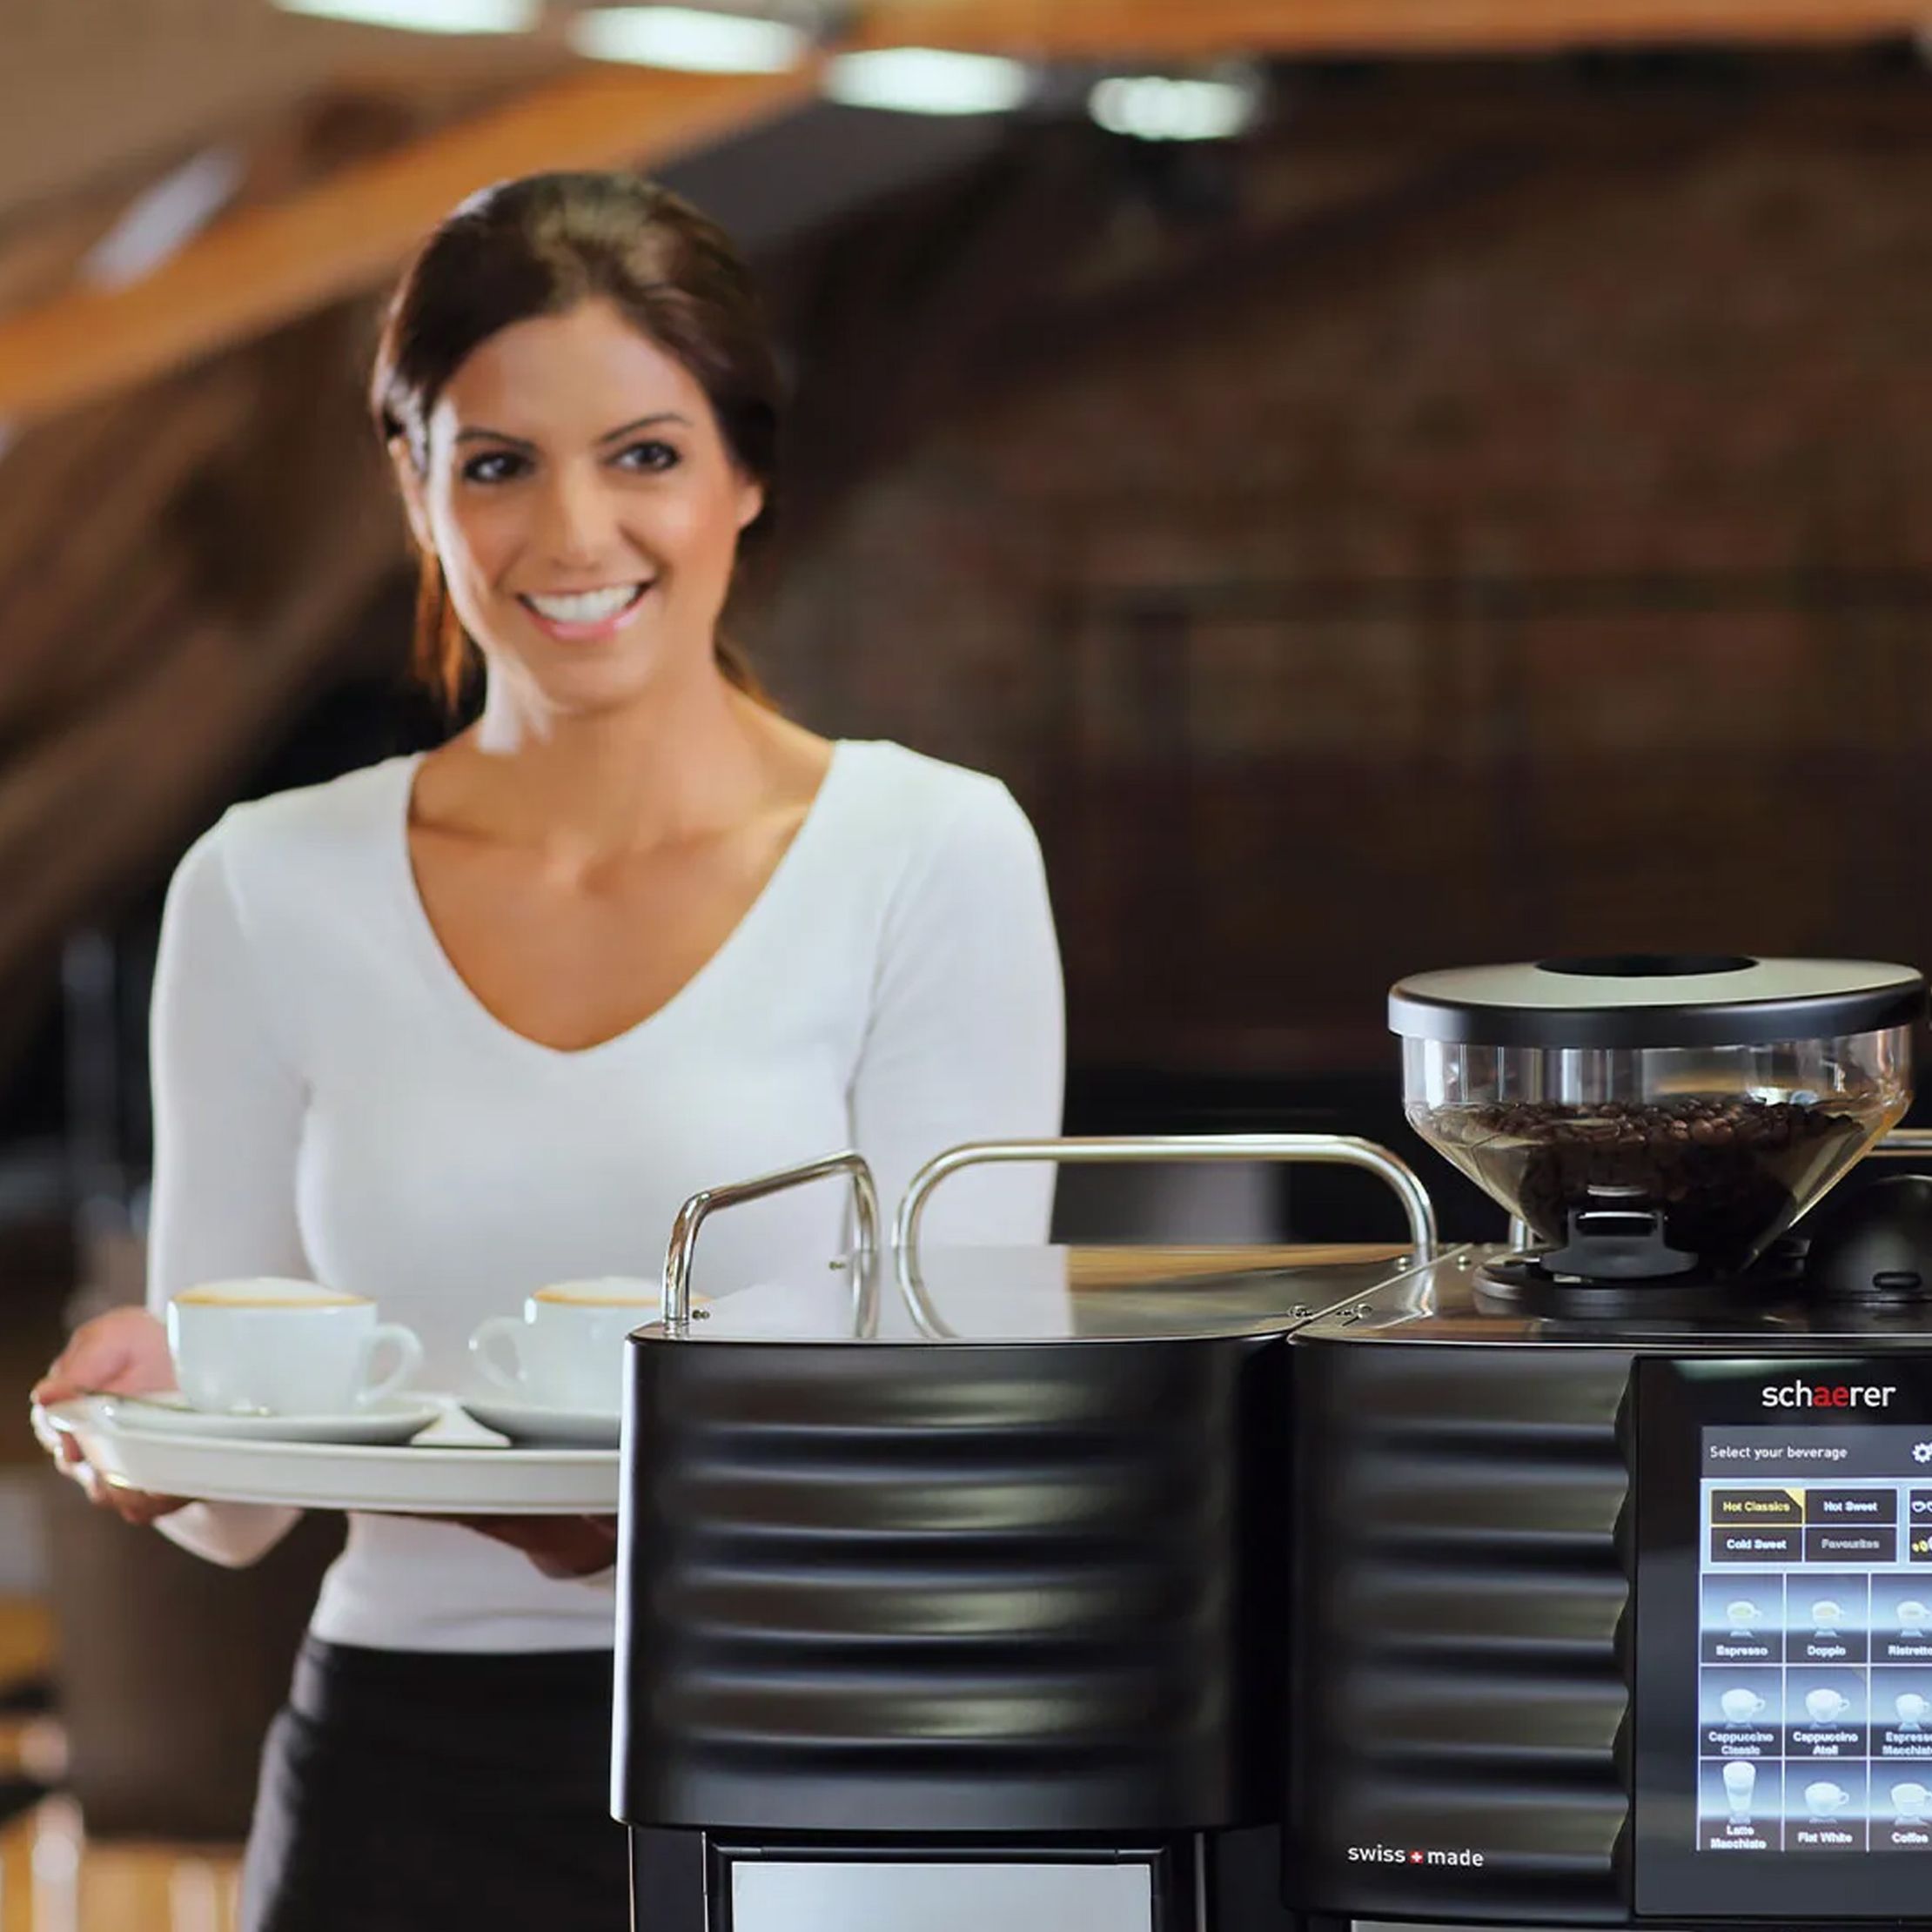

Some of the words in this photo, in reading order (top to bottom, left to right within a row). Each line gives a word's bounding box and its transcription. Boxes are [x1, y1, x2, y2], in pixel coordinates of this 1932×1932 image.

[1761, 1379, 1896, 1407] schaerer
[1710, 1446, 1751, 1459] Select
[1754, 1448, 1783, 1461] your
[1787, 1446, 1848, 1461] beverage
[1722, 1501, 1742, 1512] Hot
[1744, 1500, 1790, 1512] Classics
[1823, 1501, 1843, 1512] Hot
[1844, 1500, 1878, 1512] Sweet
[1726, 1539, 1753, 1550] Cold
[1754, 1539, 1787, 1550] Sweet
[1715, 1645, 1768, 1658] Espresso
[1807, 1645, 1847, 1658] Doppio
[1707, 1731, 1774, 1744] Cappuccino
[1792, 1731, 1859, 1744] Cappuccino
[1726, 1824, 1754, 1836] Latte
[1891, 1832, 1929, 1843] Coffee
[1348, 1844, 1406, 1863] swiss
[1427, 1848, 1484, 1867] made
